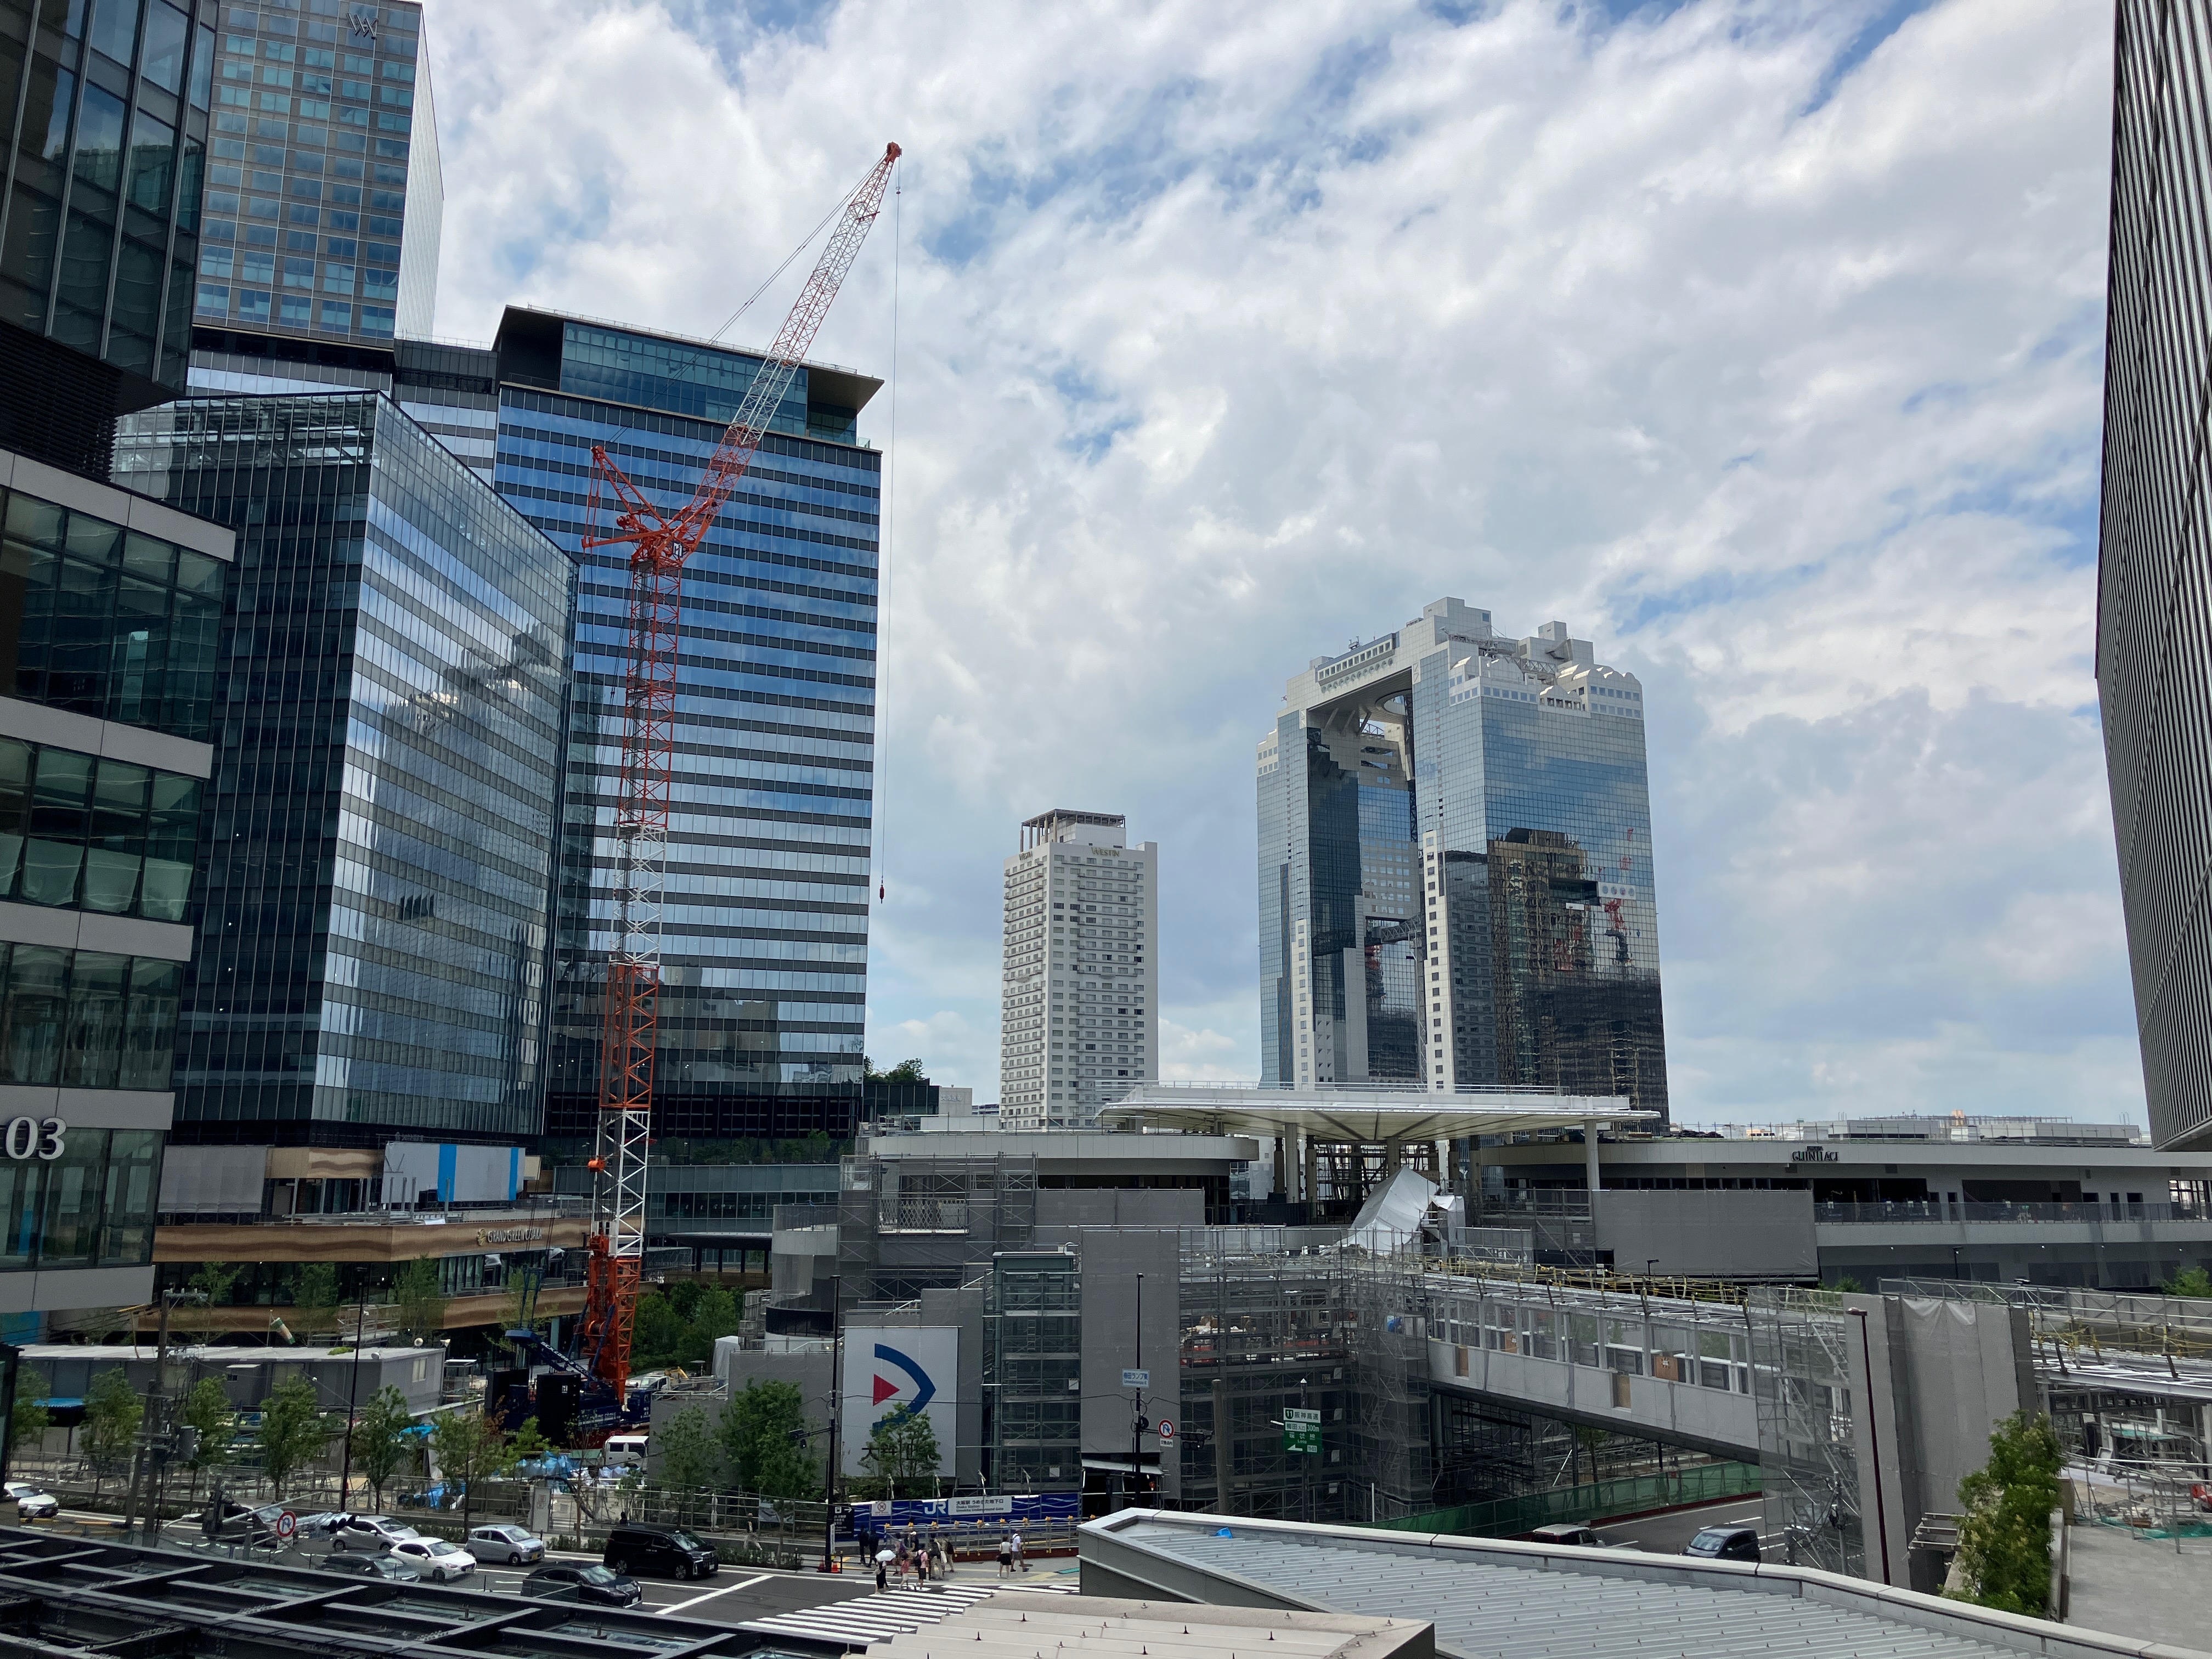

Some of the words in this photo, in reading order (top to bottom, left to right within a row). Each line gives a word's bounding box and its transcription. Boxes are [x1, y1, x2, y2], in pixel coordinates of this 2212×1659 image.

[1091, 847, 1120, 857] WESTIN
[5, 1116, 66, 1160] 03
[488, 1230, 506, 1243] GRAND
[507, 1229, 524, 1242] GREEN
[1295, 1412, 1318, 1420] 阪神高速
[1307, 1424, 1319, 1432] 300m
[924, 1502, 946, 1515] JR
